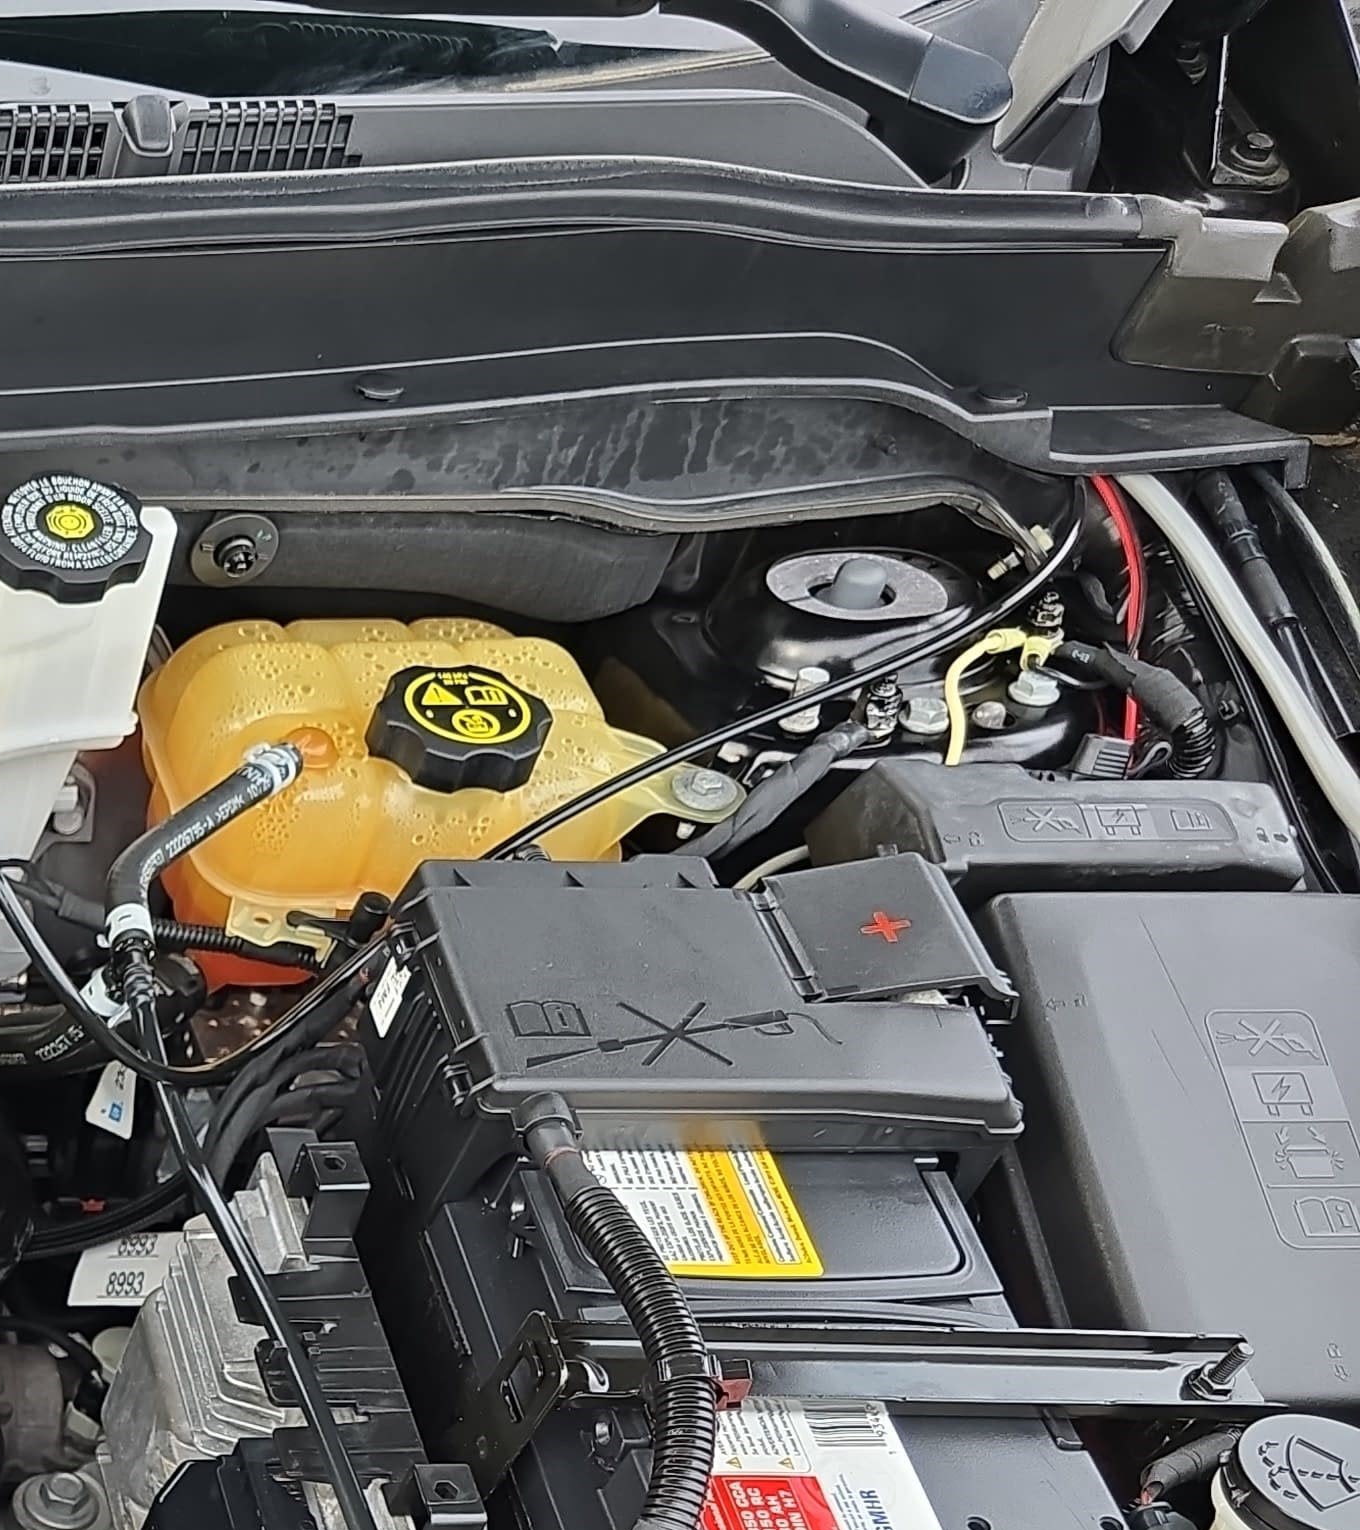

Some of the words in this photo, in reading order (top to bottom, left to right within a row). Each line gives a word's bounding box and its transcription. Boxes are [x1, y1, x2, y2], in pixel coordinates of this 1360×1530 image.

[106, 1271, 145, 1296] 8993
[729, 1482, 749, 1507] CCA
[747, 1488, 764, 1505] RC
[778, 1490, 797, 1508] H7
[766, 1496, 784, 1514] AH
